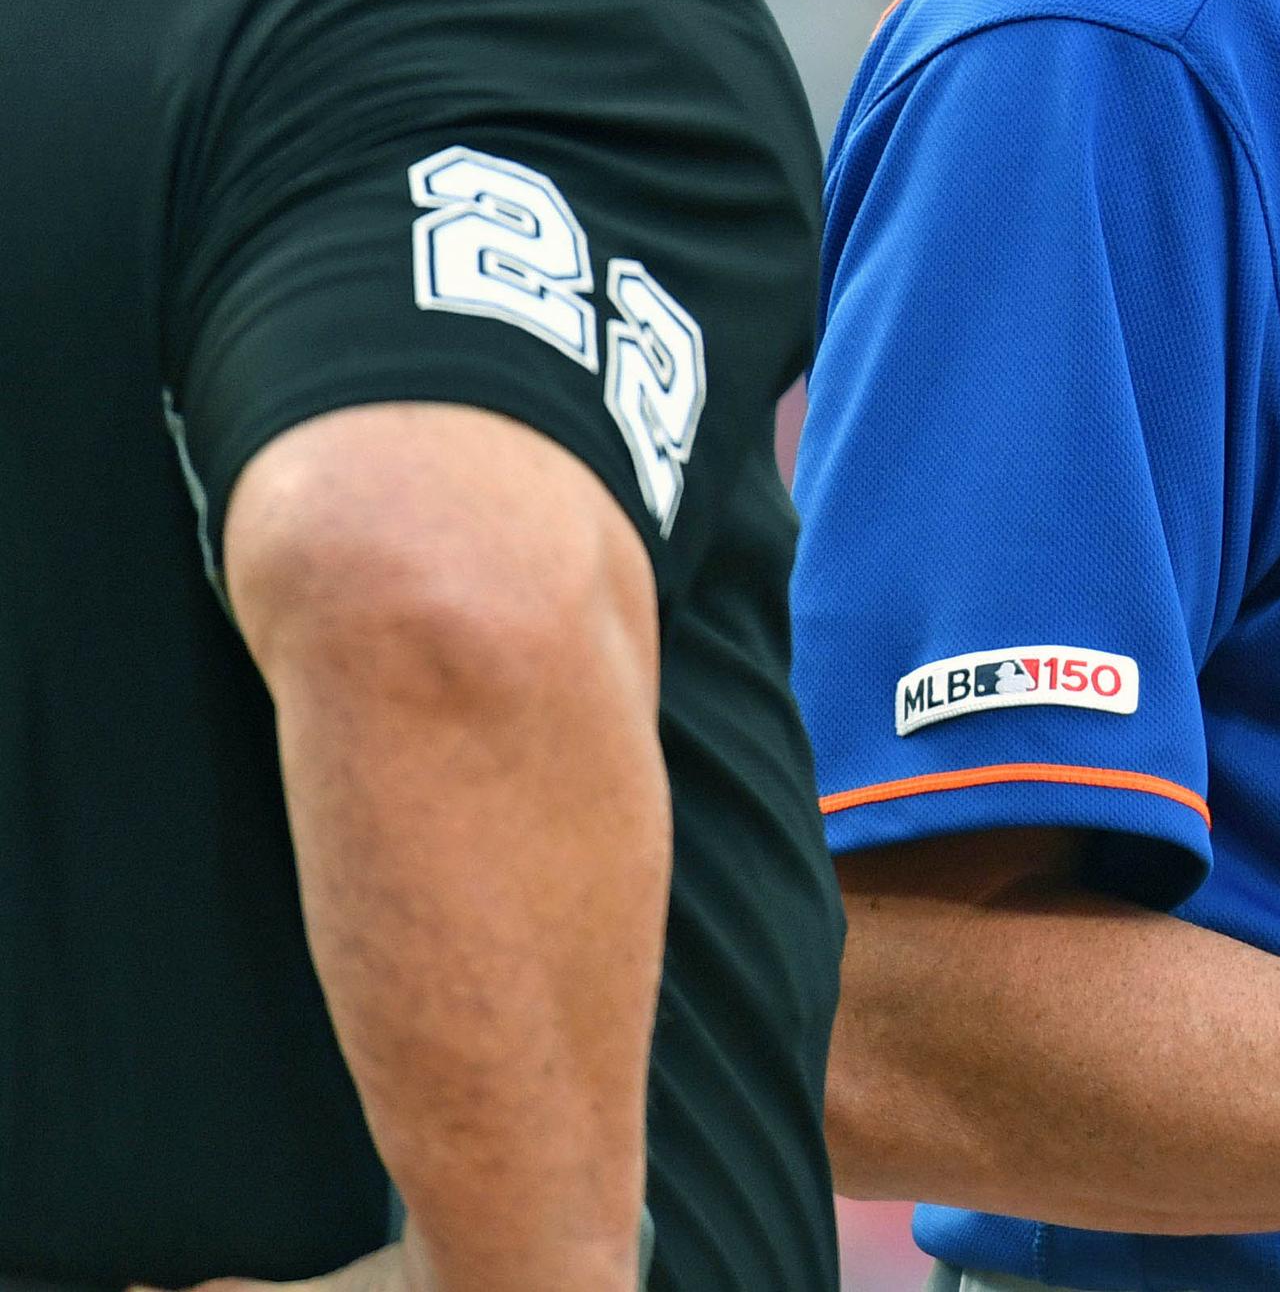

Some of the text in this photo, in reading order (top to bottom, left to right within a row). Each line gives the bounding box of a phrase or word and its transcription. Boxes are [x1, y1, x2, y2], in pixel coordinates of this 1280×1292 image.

[407, 144, 706, 540] 22
[904, 657, 1121, 721] MLB 150
